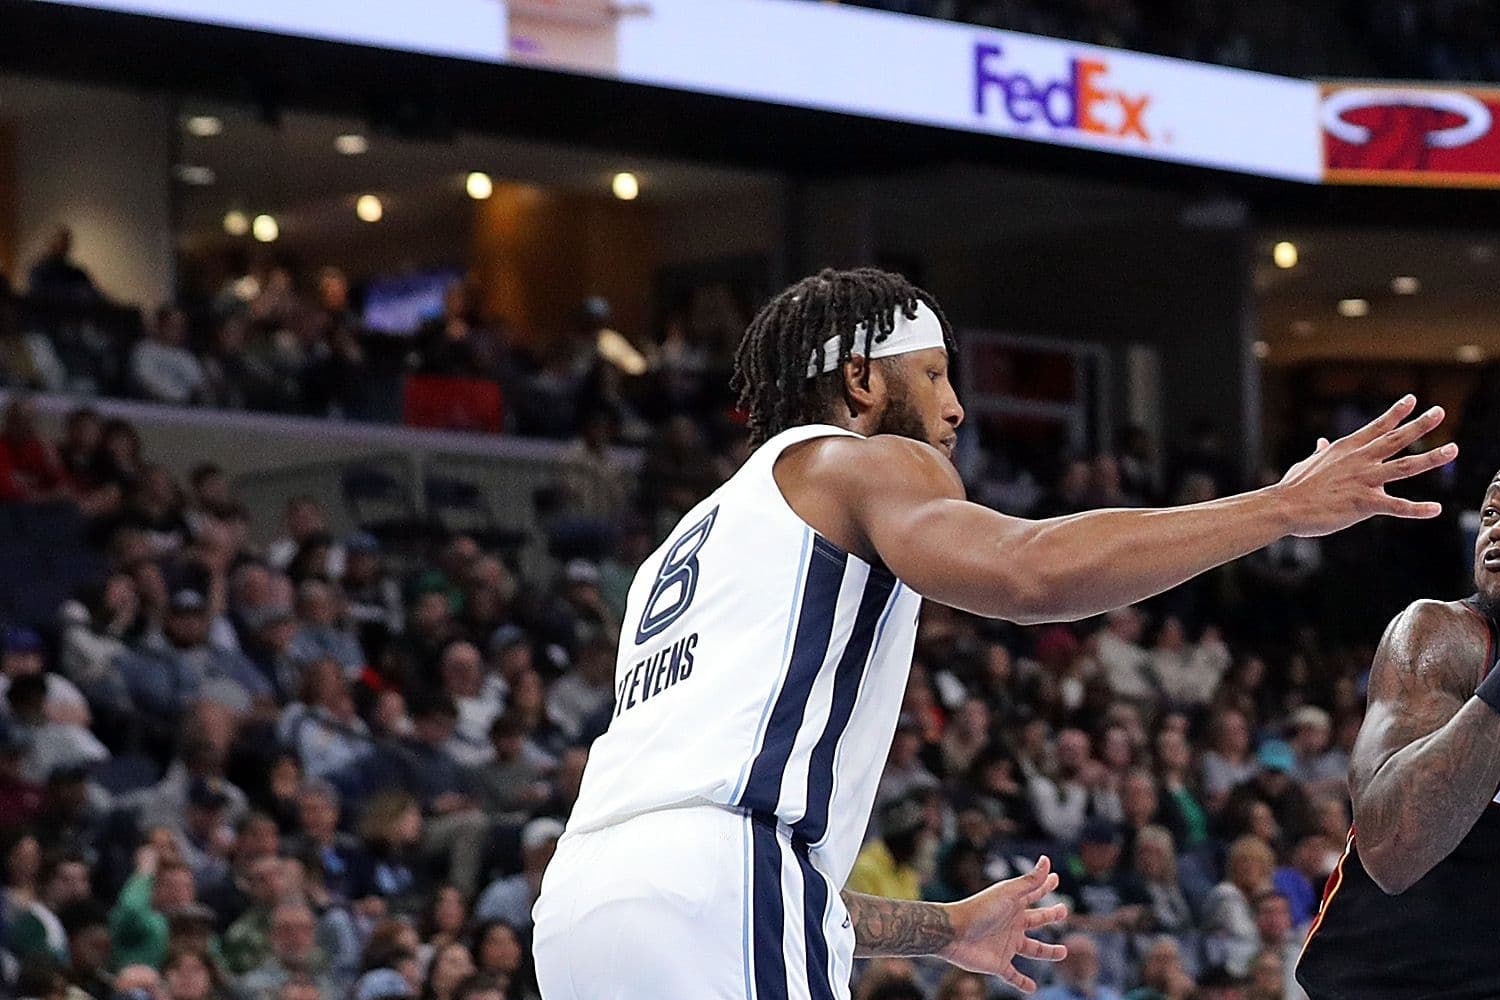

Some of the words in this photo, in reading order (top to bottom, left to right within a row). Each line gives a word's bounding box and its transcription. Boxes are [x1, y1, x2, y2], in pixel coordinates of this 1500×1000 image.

[974, 41, 1151, 141] FedEx
[635, 504, 720, 645] 8
[617, 632, 699, 717] TEVENS
